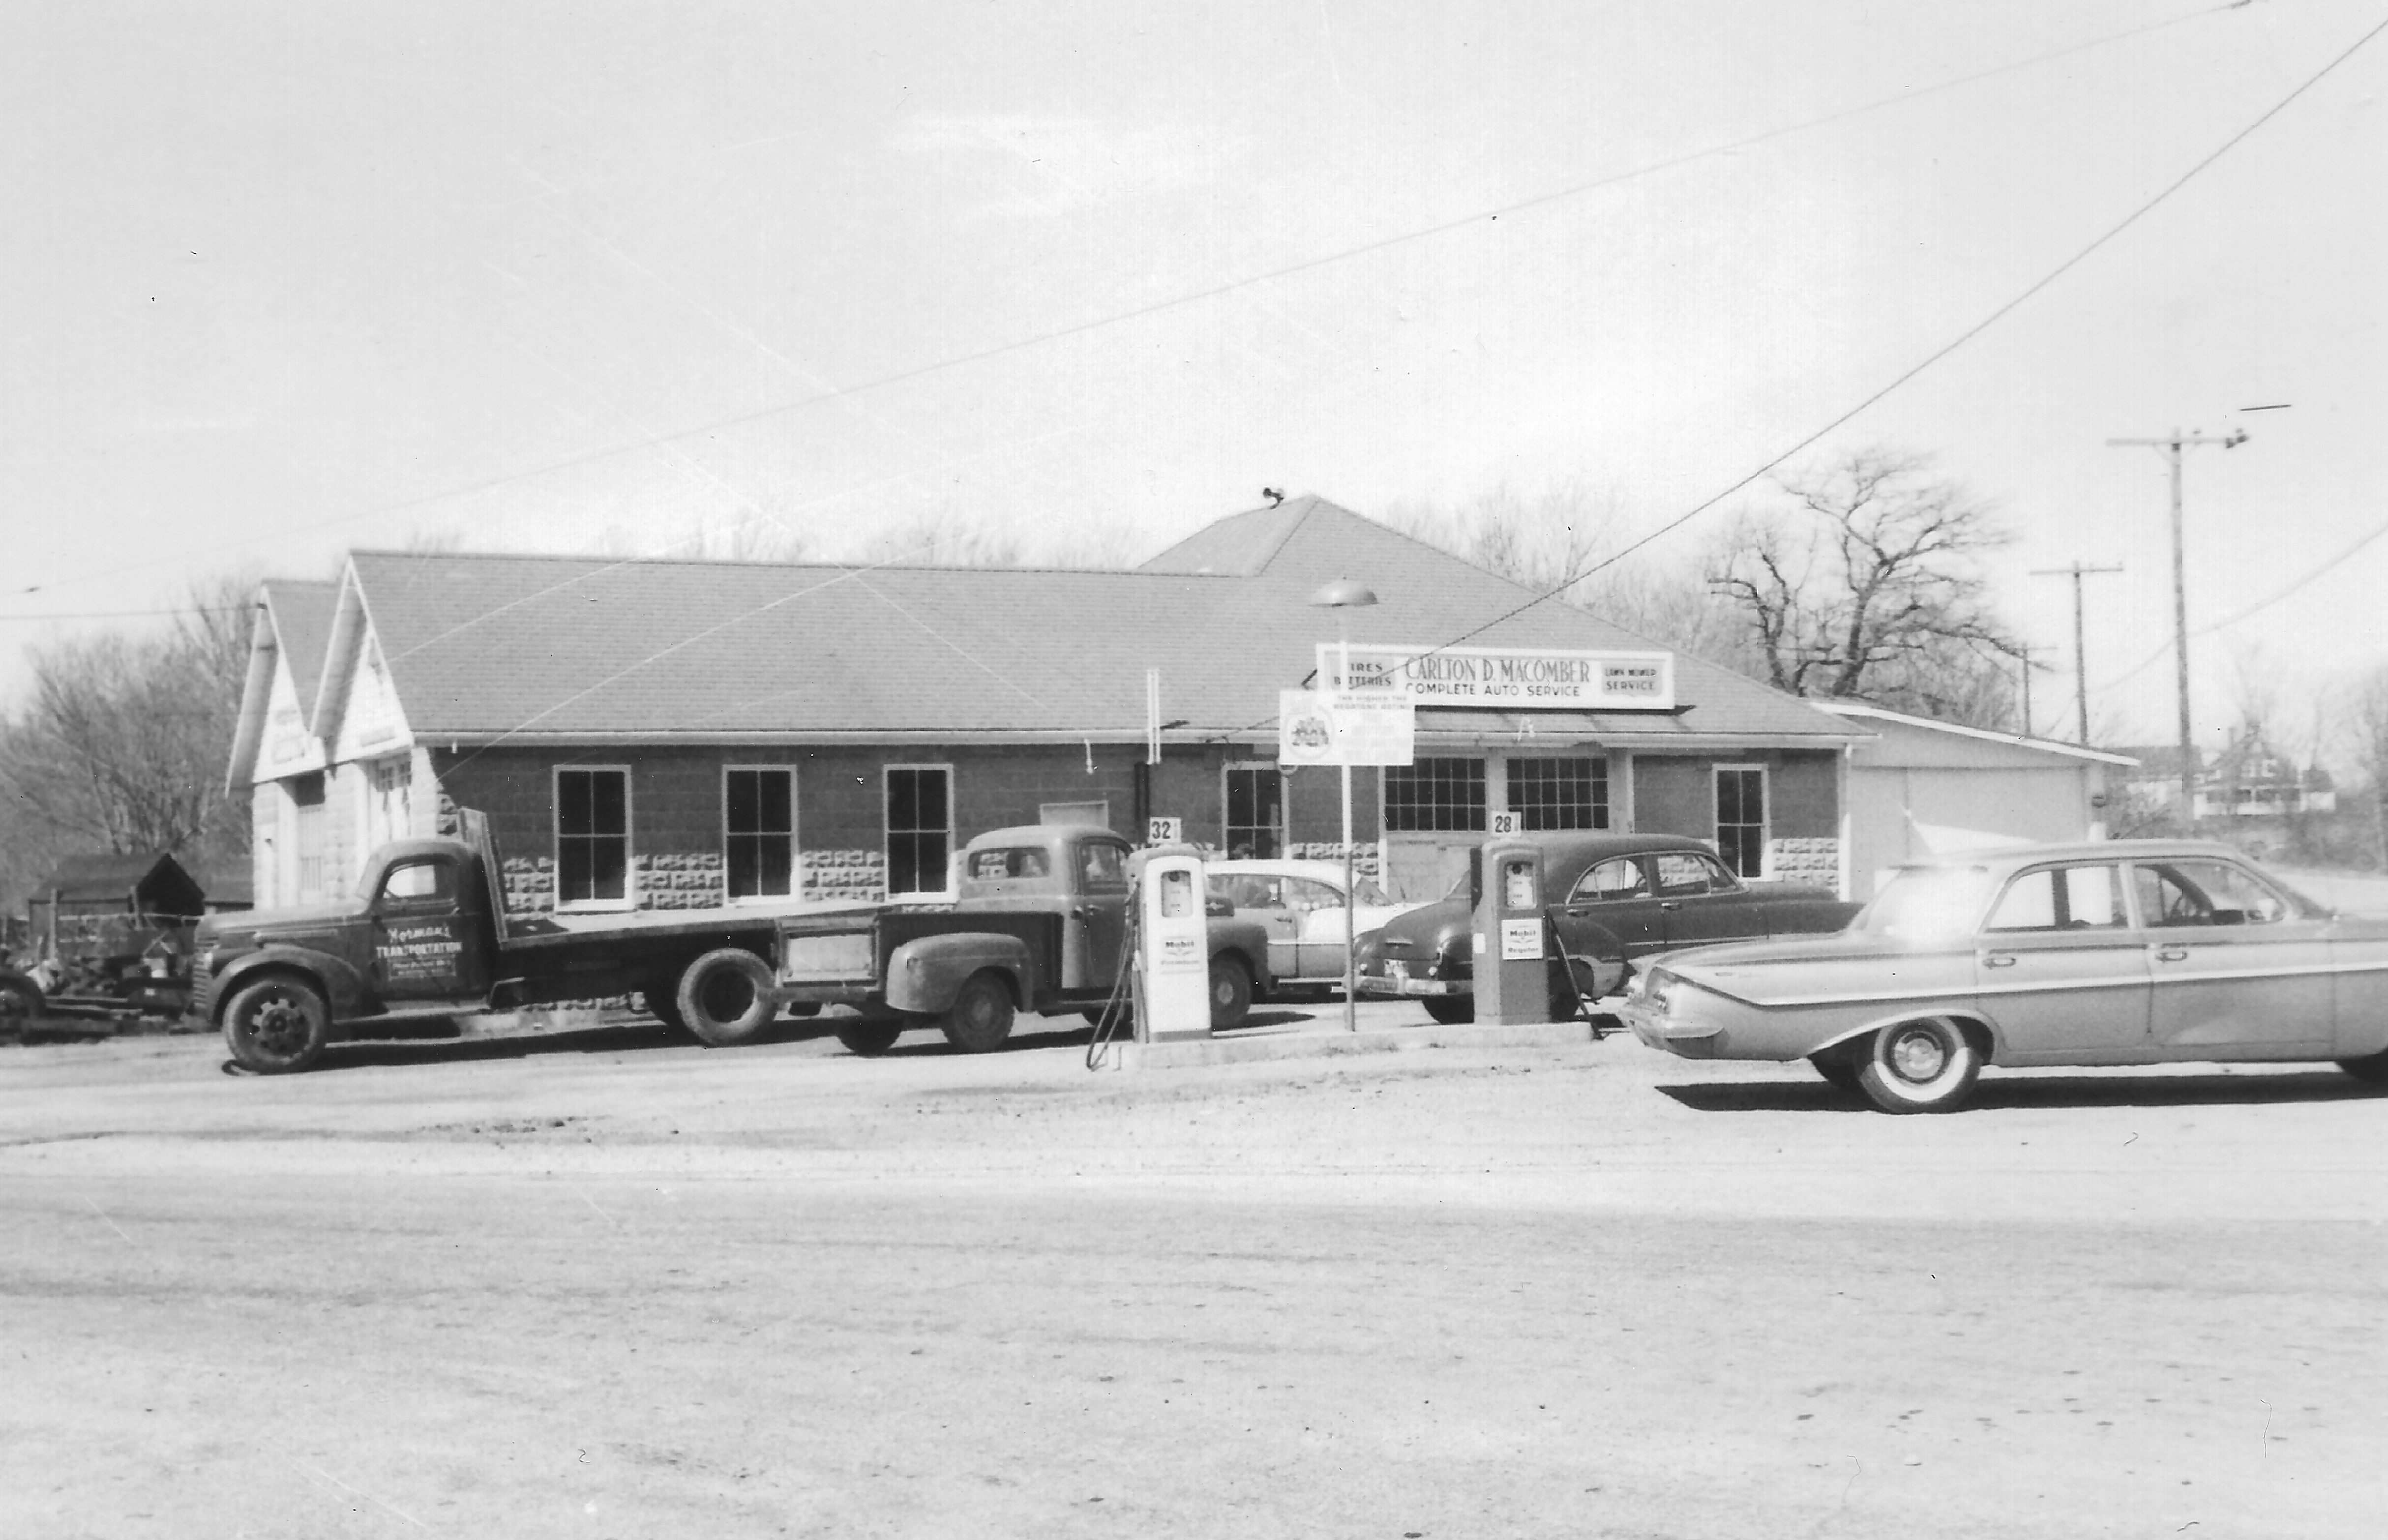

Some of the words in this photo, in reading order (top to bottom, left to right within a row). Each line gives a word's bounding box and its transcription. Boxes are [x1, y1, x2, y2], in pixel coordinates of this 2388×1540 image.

[1350, 662, 1383, 672] IRES
[1405, 657, 1476, 681] CARLTON
[1483, 658, 1496, 681] D.
[1500, 659, 1589, 682] MACOMBER
[1334, 676, 1391, 686] BTTERIES
[1606, 681, 1655, 690] SERVICE
[1406, 682, 1476, 695] COMPLETE
[1484, 684, 1519, 696] AUTO
[1527, 685, 1581, 697] SERVICE
[1152, 821, 1171, 839] 32
[1495, 816, 1511, 832] 28
